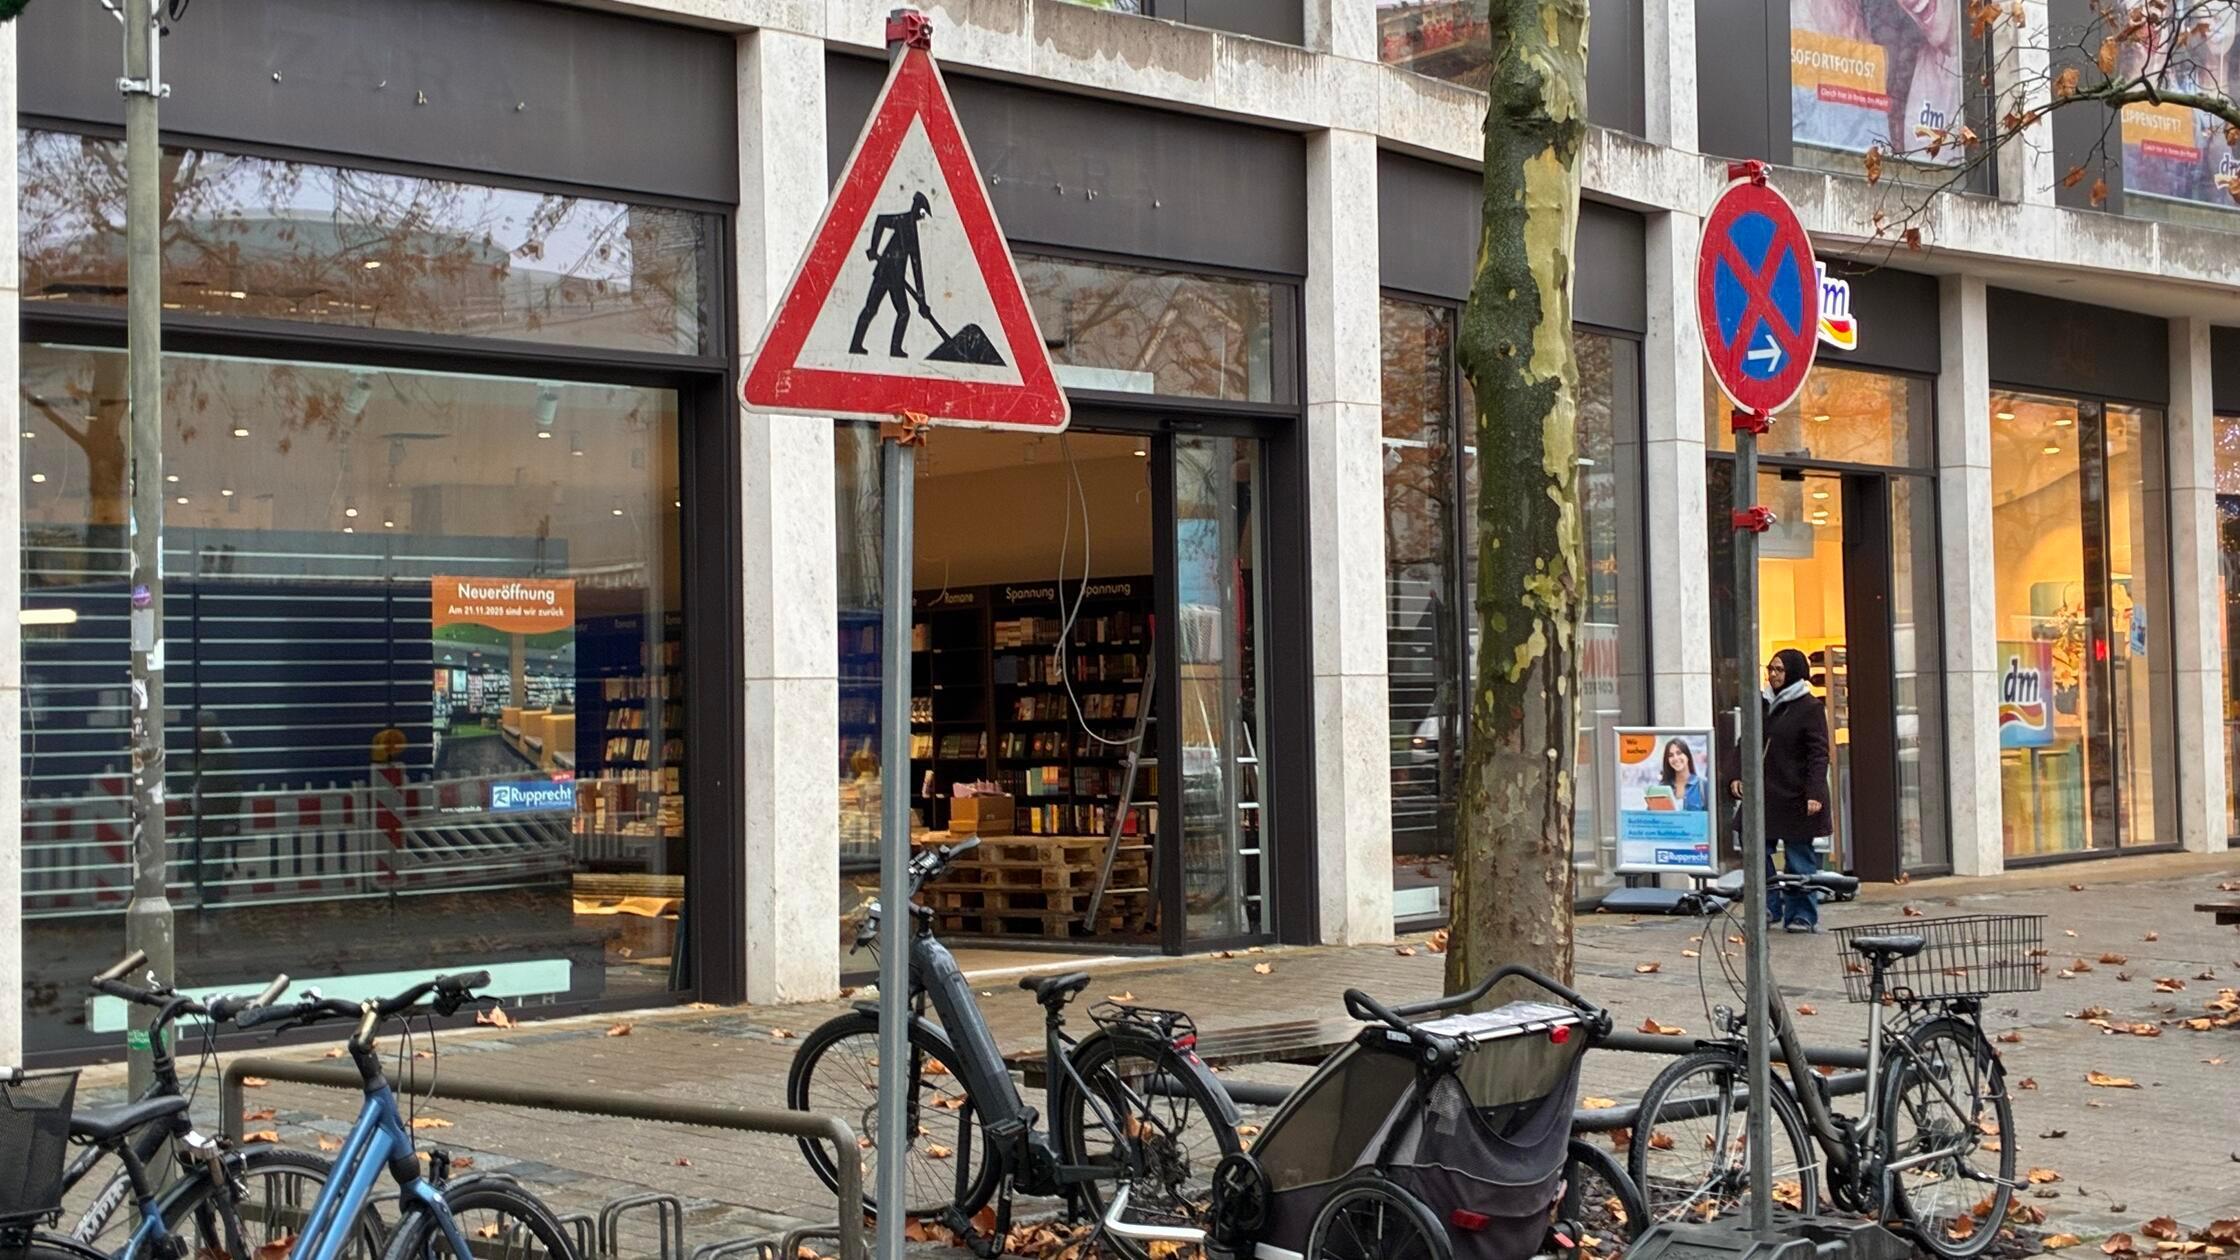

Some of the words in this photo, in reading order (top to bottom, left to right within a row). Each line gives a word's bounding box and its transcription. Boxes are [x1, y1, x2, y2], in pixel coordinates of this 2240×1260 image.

[1790, 48, 1876, 78] SOFORTFOTOS?
[1920, 102, 1945, 128] dm
[1815, 267, 1846, 316] m
[458, 583, 555, 605] Neueröffnung
[1006, 586, 1055, 603] Spannung
[448, 605, 463, 615] Am
[505, 606, 522, 616] sind
[523, 607, 536, 616] wir
[539, 606, 564, 617] zurück
[2004, 658, 2039, 702] dm
[511, 784, 572, 806] Rupprecht
[1669, 850, 1709, 864] Rupprecht
